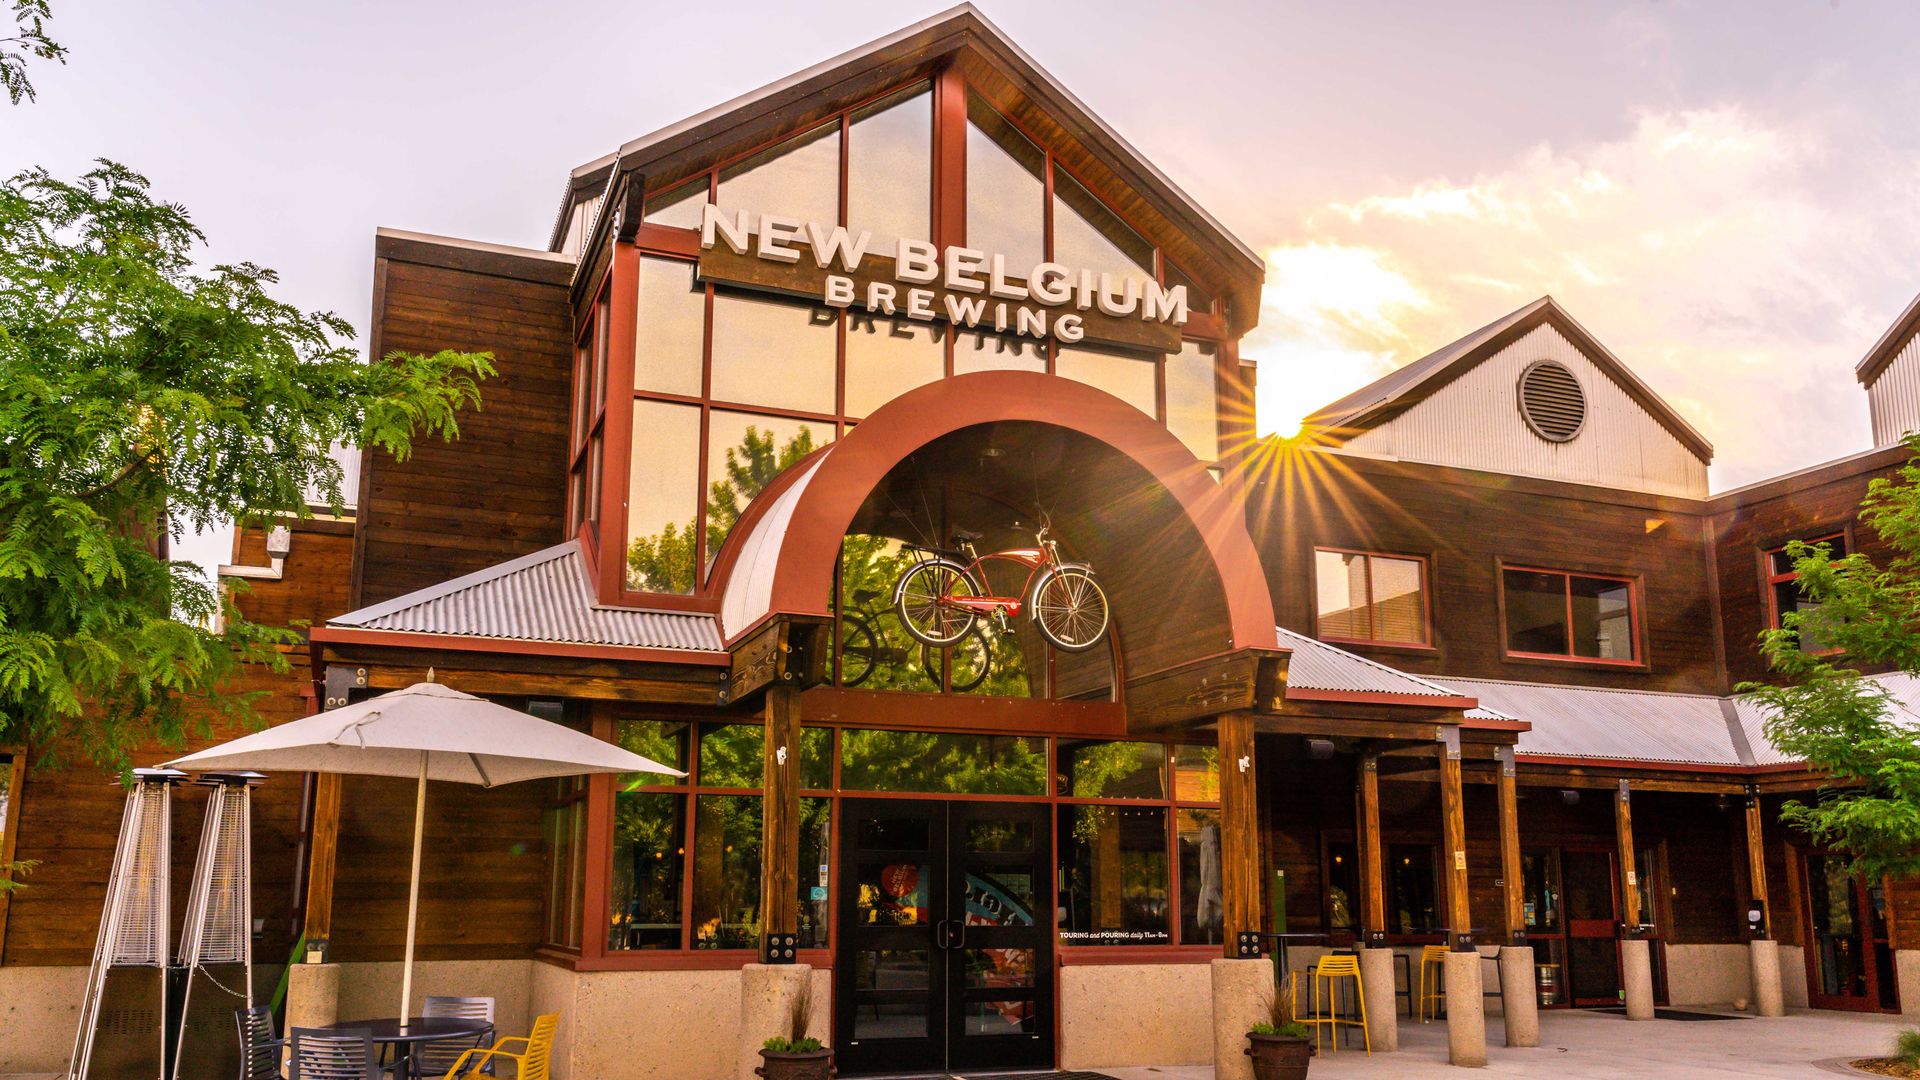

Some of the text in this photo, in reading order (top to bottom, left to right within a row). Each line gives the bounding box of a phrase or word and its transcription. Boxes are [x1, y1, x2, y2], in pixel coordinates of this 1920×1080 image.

[702, 203, 1188, 325] NEW BELGIUM
[824, 274, 1085, 343] BREWING
[1060, 931, 1089, 939] TOURING
[1089, 931, 1100, 939] and
[1100, 931, 1130, 939] POURING
